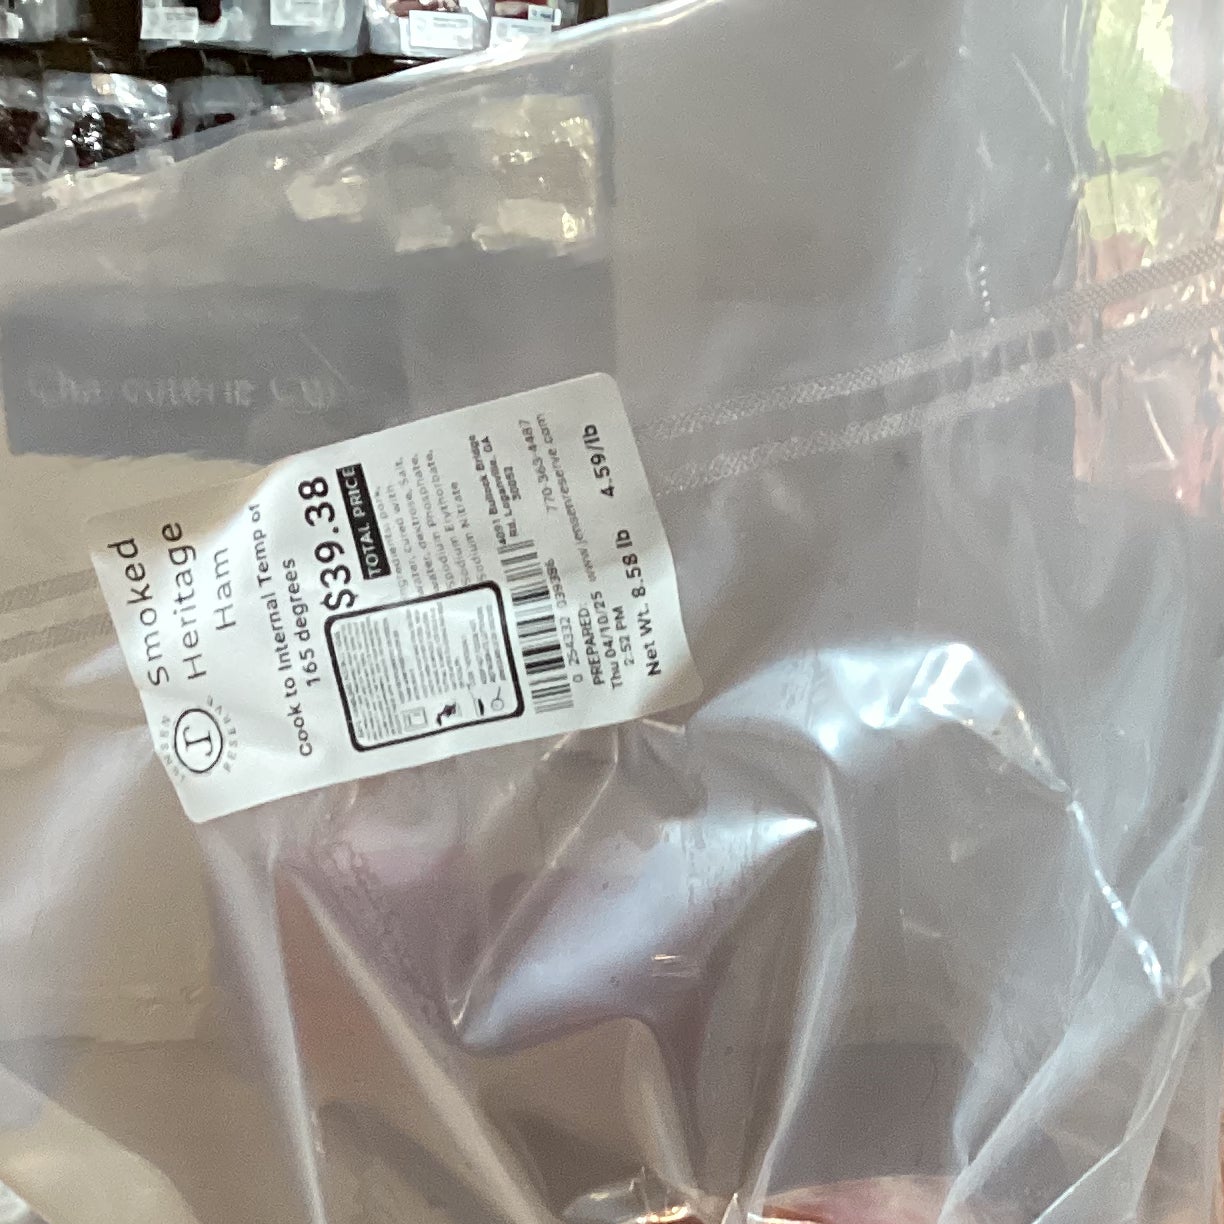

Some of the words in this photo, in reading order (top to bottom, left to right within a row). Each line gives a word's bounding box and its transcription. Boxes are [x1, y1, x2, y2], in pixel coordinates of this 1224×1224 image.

[583, 424, 615, 498] 4.59/lb
[247, 502, 262, 522] of
[341, 465, 367, 519] PRICE
[384, 483, 400, 513] with
[249, 527, 272, 587] Temp
[296, 475, 356, 611] $39.38
[357, 521, 383, 577] TOTAL
[393, 515, 412, 554] cured
[464, 532, 486, 581] Sodium
[612, 527, 633, 550] lb
[449, 536, 471, 584] Sodium
[620, 552, 647, 598] 8.58
[107, 536, 170, 687] Smoked
[160, 521, 208, 681] Heritage
[210, 548, 237, 632] Ham
[281, 558, 311, 643] degrees
[262, 593, 294, 672] Internal
[591, 589, 619, 659] 04/10/25
[611, 604, 627, 631] PM
[634, 603, 653, 635] Wt.
[297, 646, 322, 687] 165
[618, 633, 635, 666] 2:52
[642, 640, 663, 676] Net
[281, 675, 297, 697] to
[607, 660, 624, 689] Thu
[286, 702, 314, 757] Cook
